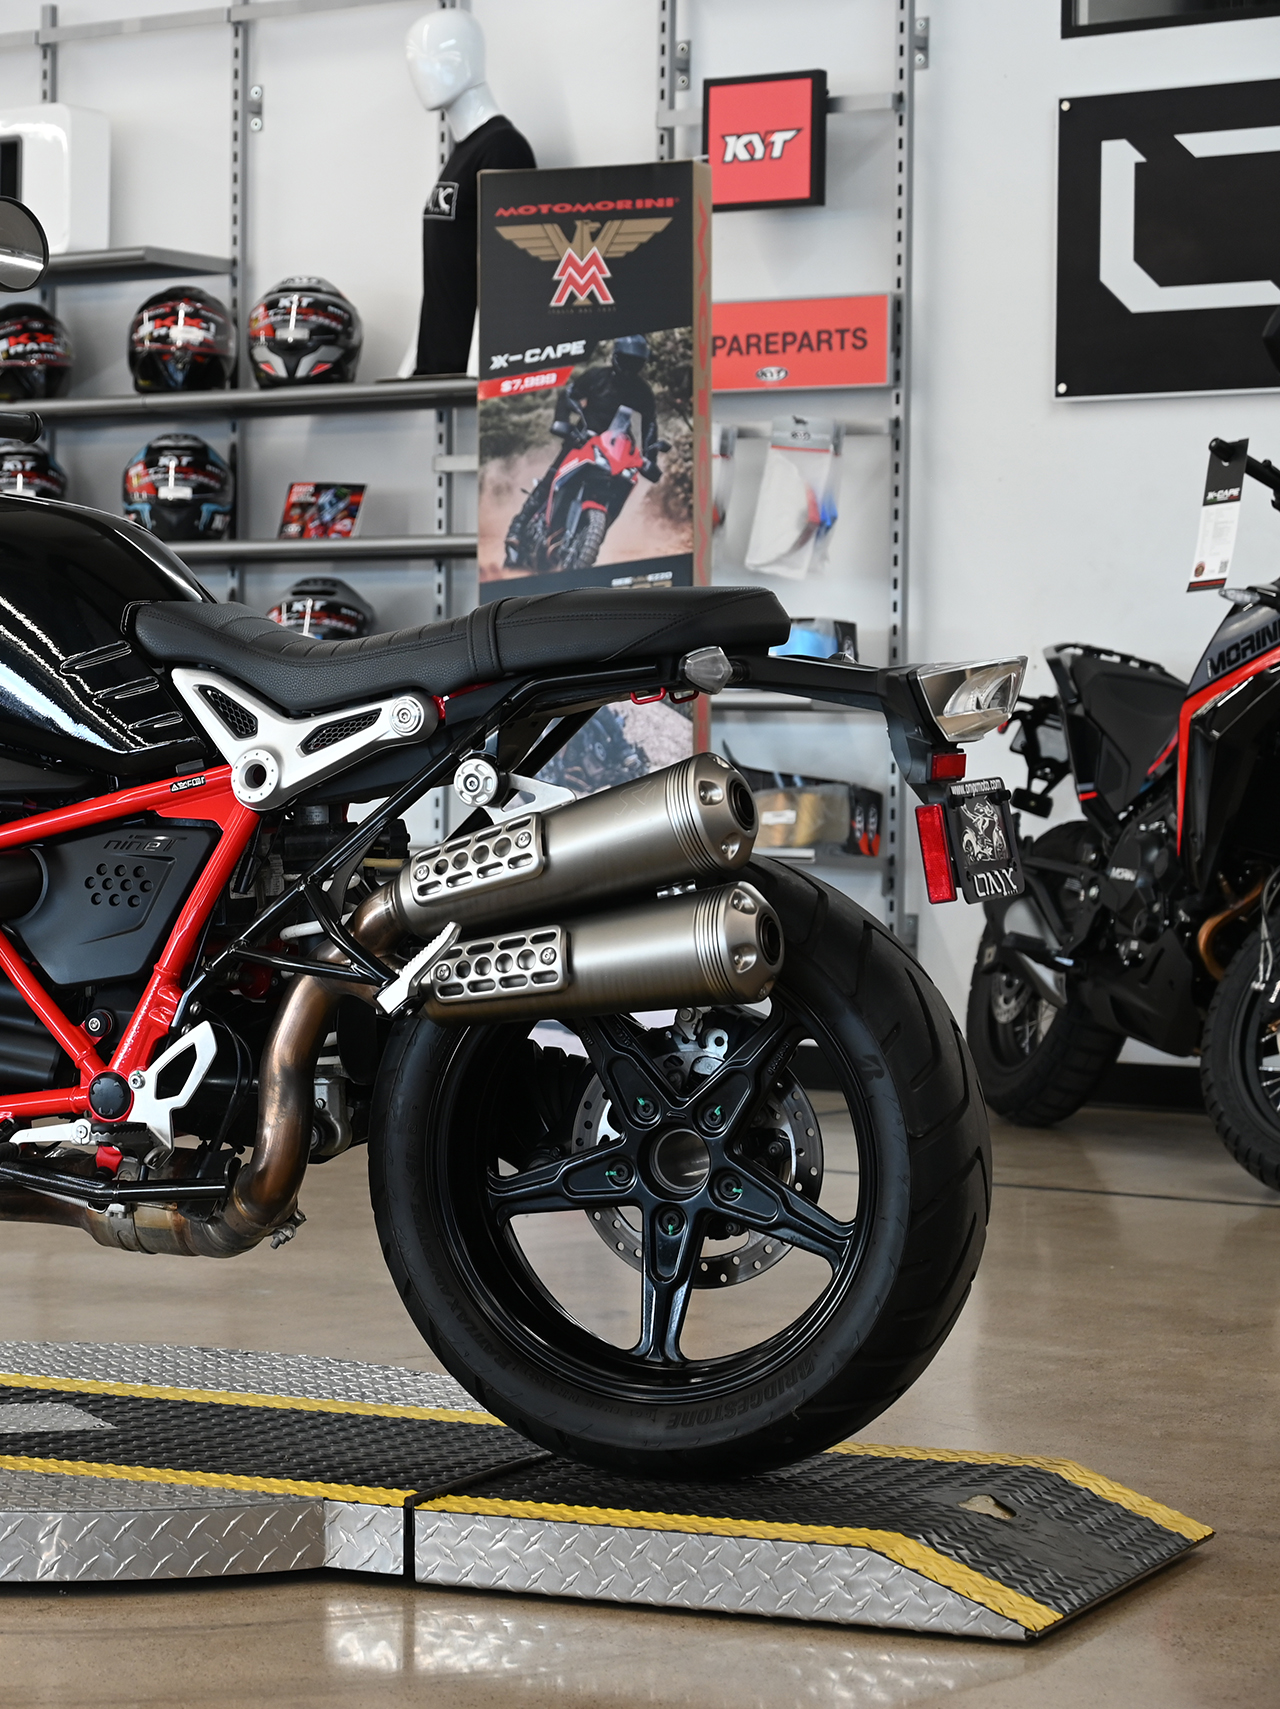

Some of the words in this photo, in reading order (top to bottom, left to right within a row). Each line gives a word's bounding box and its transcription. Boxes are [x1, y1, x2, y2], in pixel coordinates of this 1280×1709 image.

[722, 127, 803, 163] KYT
[489, 340, 586, 370] X-CAPE
[711, 327, 869, 358] PAREPARTS
